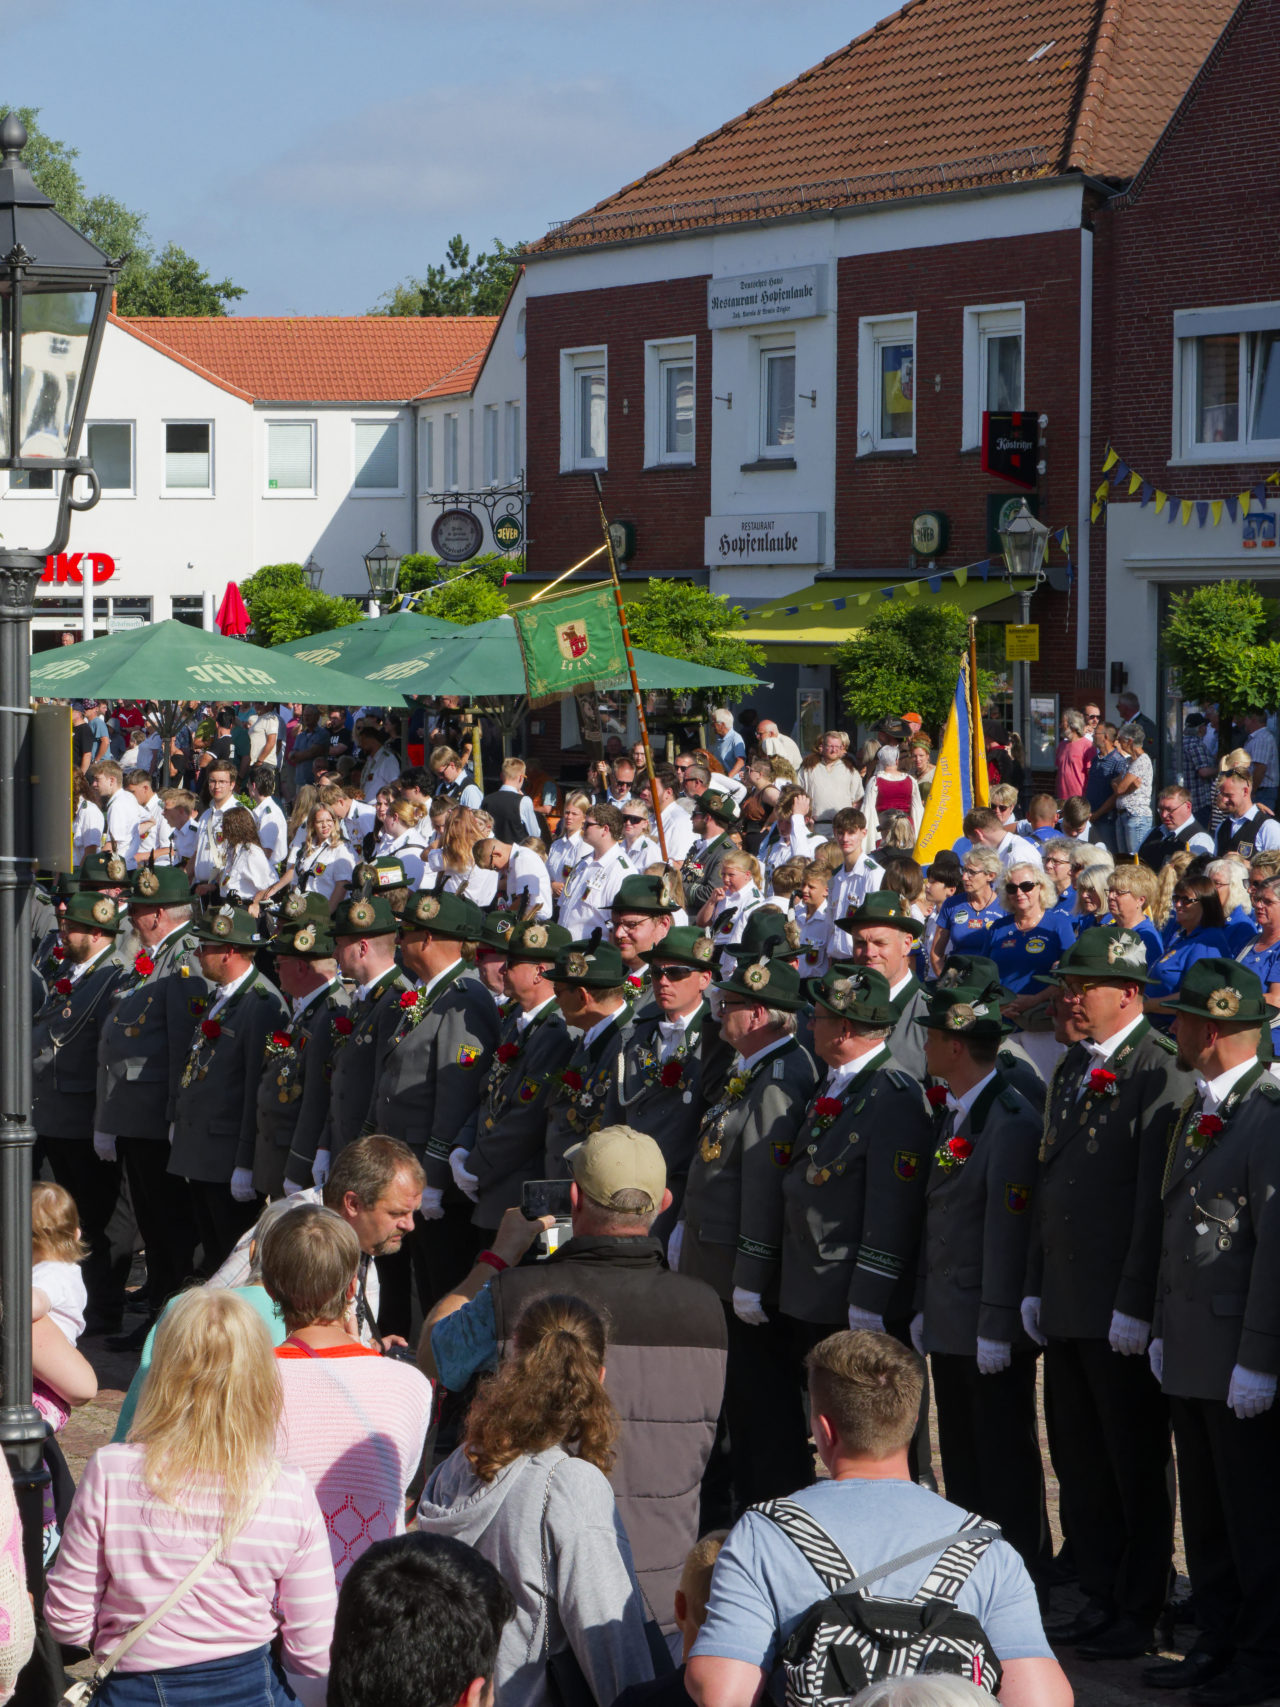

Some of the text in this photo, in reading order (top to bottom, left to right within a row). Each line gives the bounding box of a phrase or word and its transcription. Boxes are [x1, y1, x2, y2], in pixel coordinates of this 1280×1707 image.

[711, 284, 814, 310] Restaurant Hopfenlaube
[497, 528, 519, 540] JEVER
[741, 521, 775, 531] RESTAURANT
[718, 531, 798, 559] Hopfenlaube
[185, 663, 277, 685] JEVER
